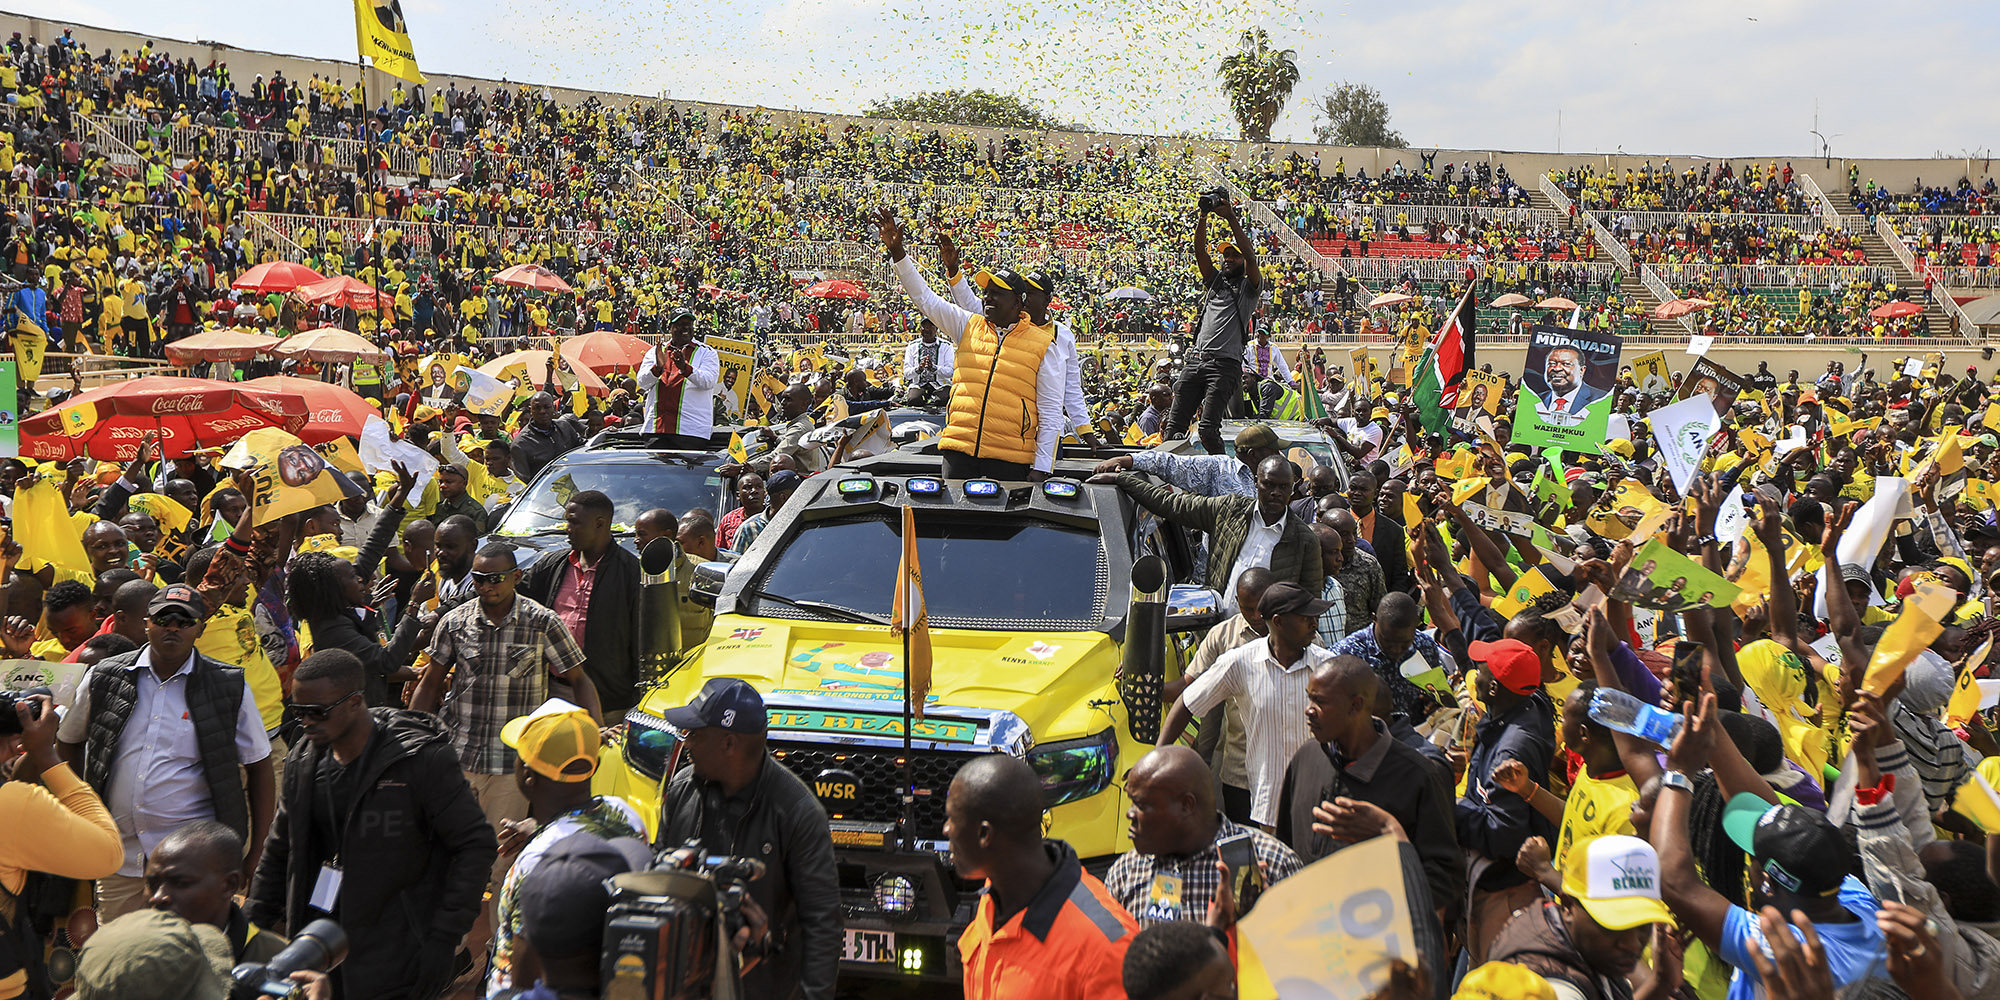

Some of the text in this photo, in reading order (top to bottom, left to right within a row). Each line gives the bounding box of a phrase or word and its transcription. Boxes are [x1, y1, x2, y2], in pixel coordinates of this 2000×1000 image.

[1535, 335, 1616, 355] MUDAVADI
[719, 360, 747, 372] ARIGA
[521, 369, 535, 391] RUTO
[1472, 371, 1498, 384] RUTO
[152, 394, 205, 414] Coca-Cola
[1533, 424, 1585, 437] WAZIRI MKUU
[1689, 432, 1704, 455] AN
[1002, 656, 1027, 664] KENYA
[13, 674, 45, 682] ANC
[823, 691, 871, 699] BELONGS
[721, 708, 736, 728] 3
[821, 715, 968, 738] BEAST
[815, 781, 856, 800] WSR
[1148, 905, 1174, 921] AAA
